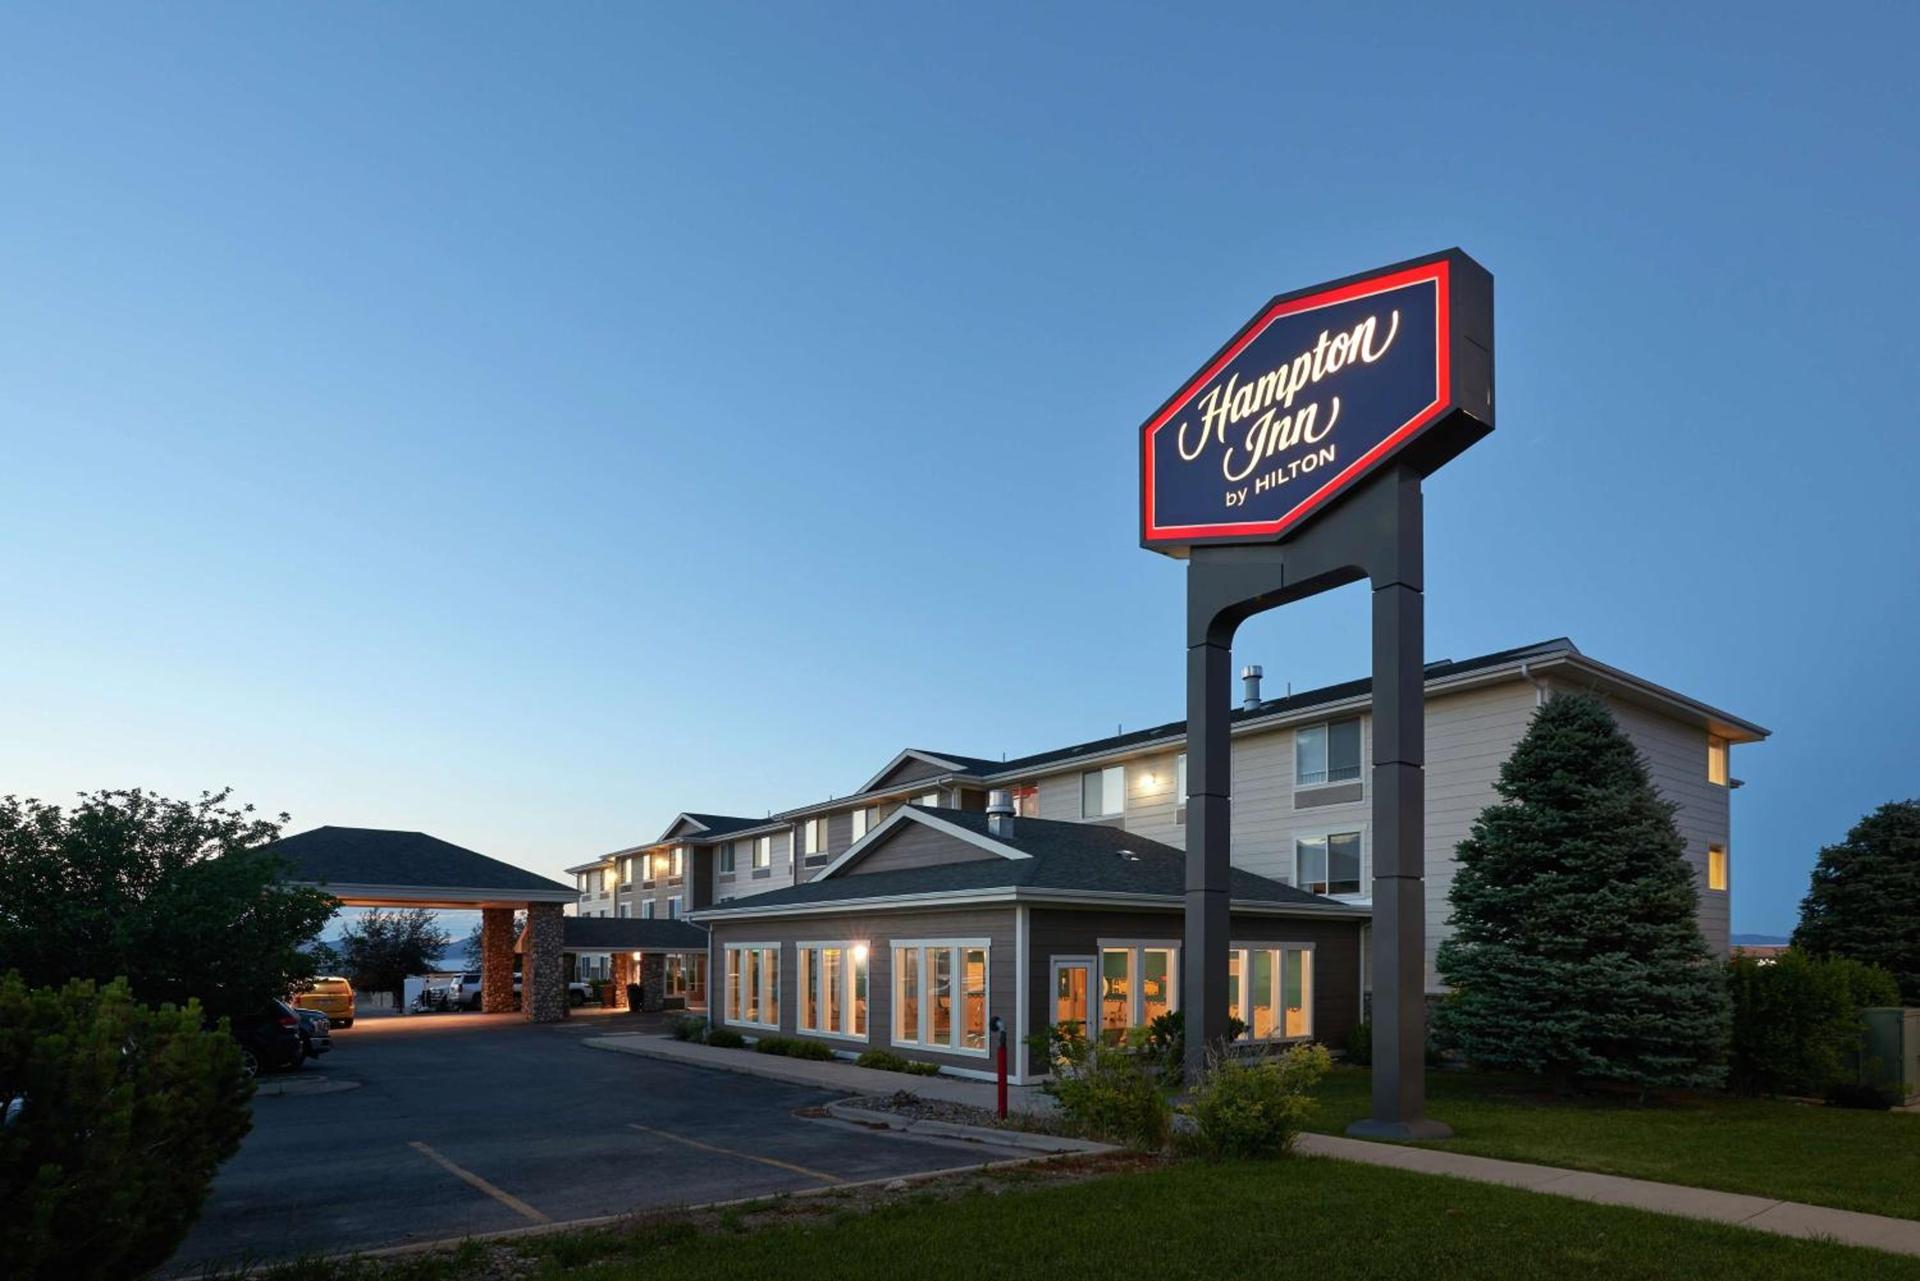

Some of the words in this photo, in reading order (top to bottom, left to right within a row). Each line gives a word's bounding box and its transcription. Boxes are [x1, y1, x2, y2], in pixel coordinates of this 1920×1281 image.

[1178, 310, 1399, 461] Hampton
[1223, 396, 1340, 482] Inn
[1225, 487, 1248, 507] by
[1255, 444, 1335, 495] HILTON
